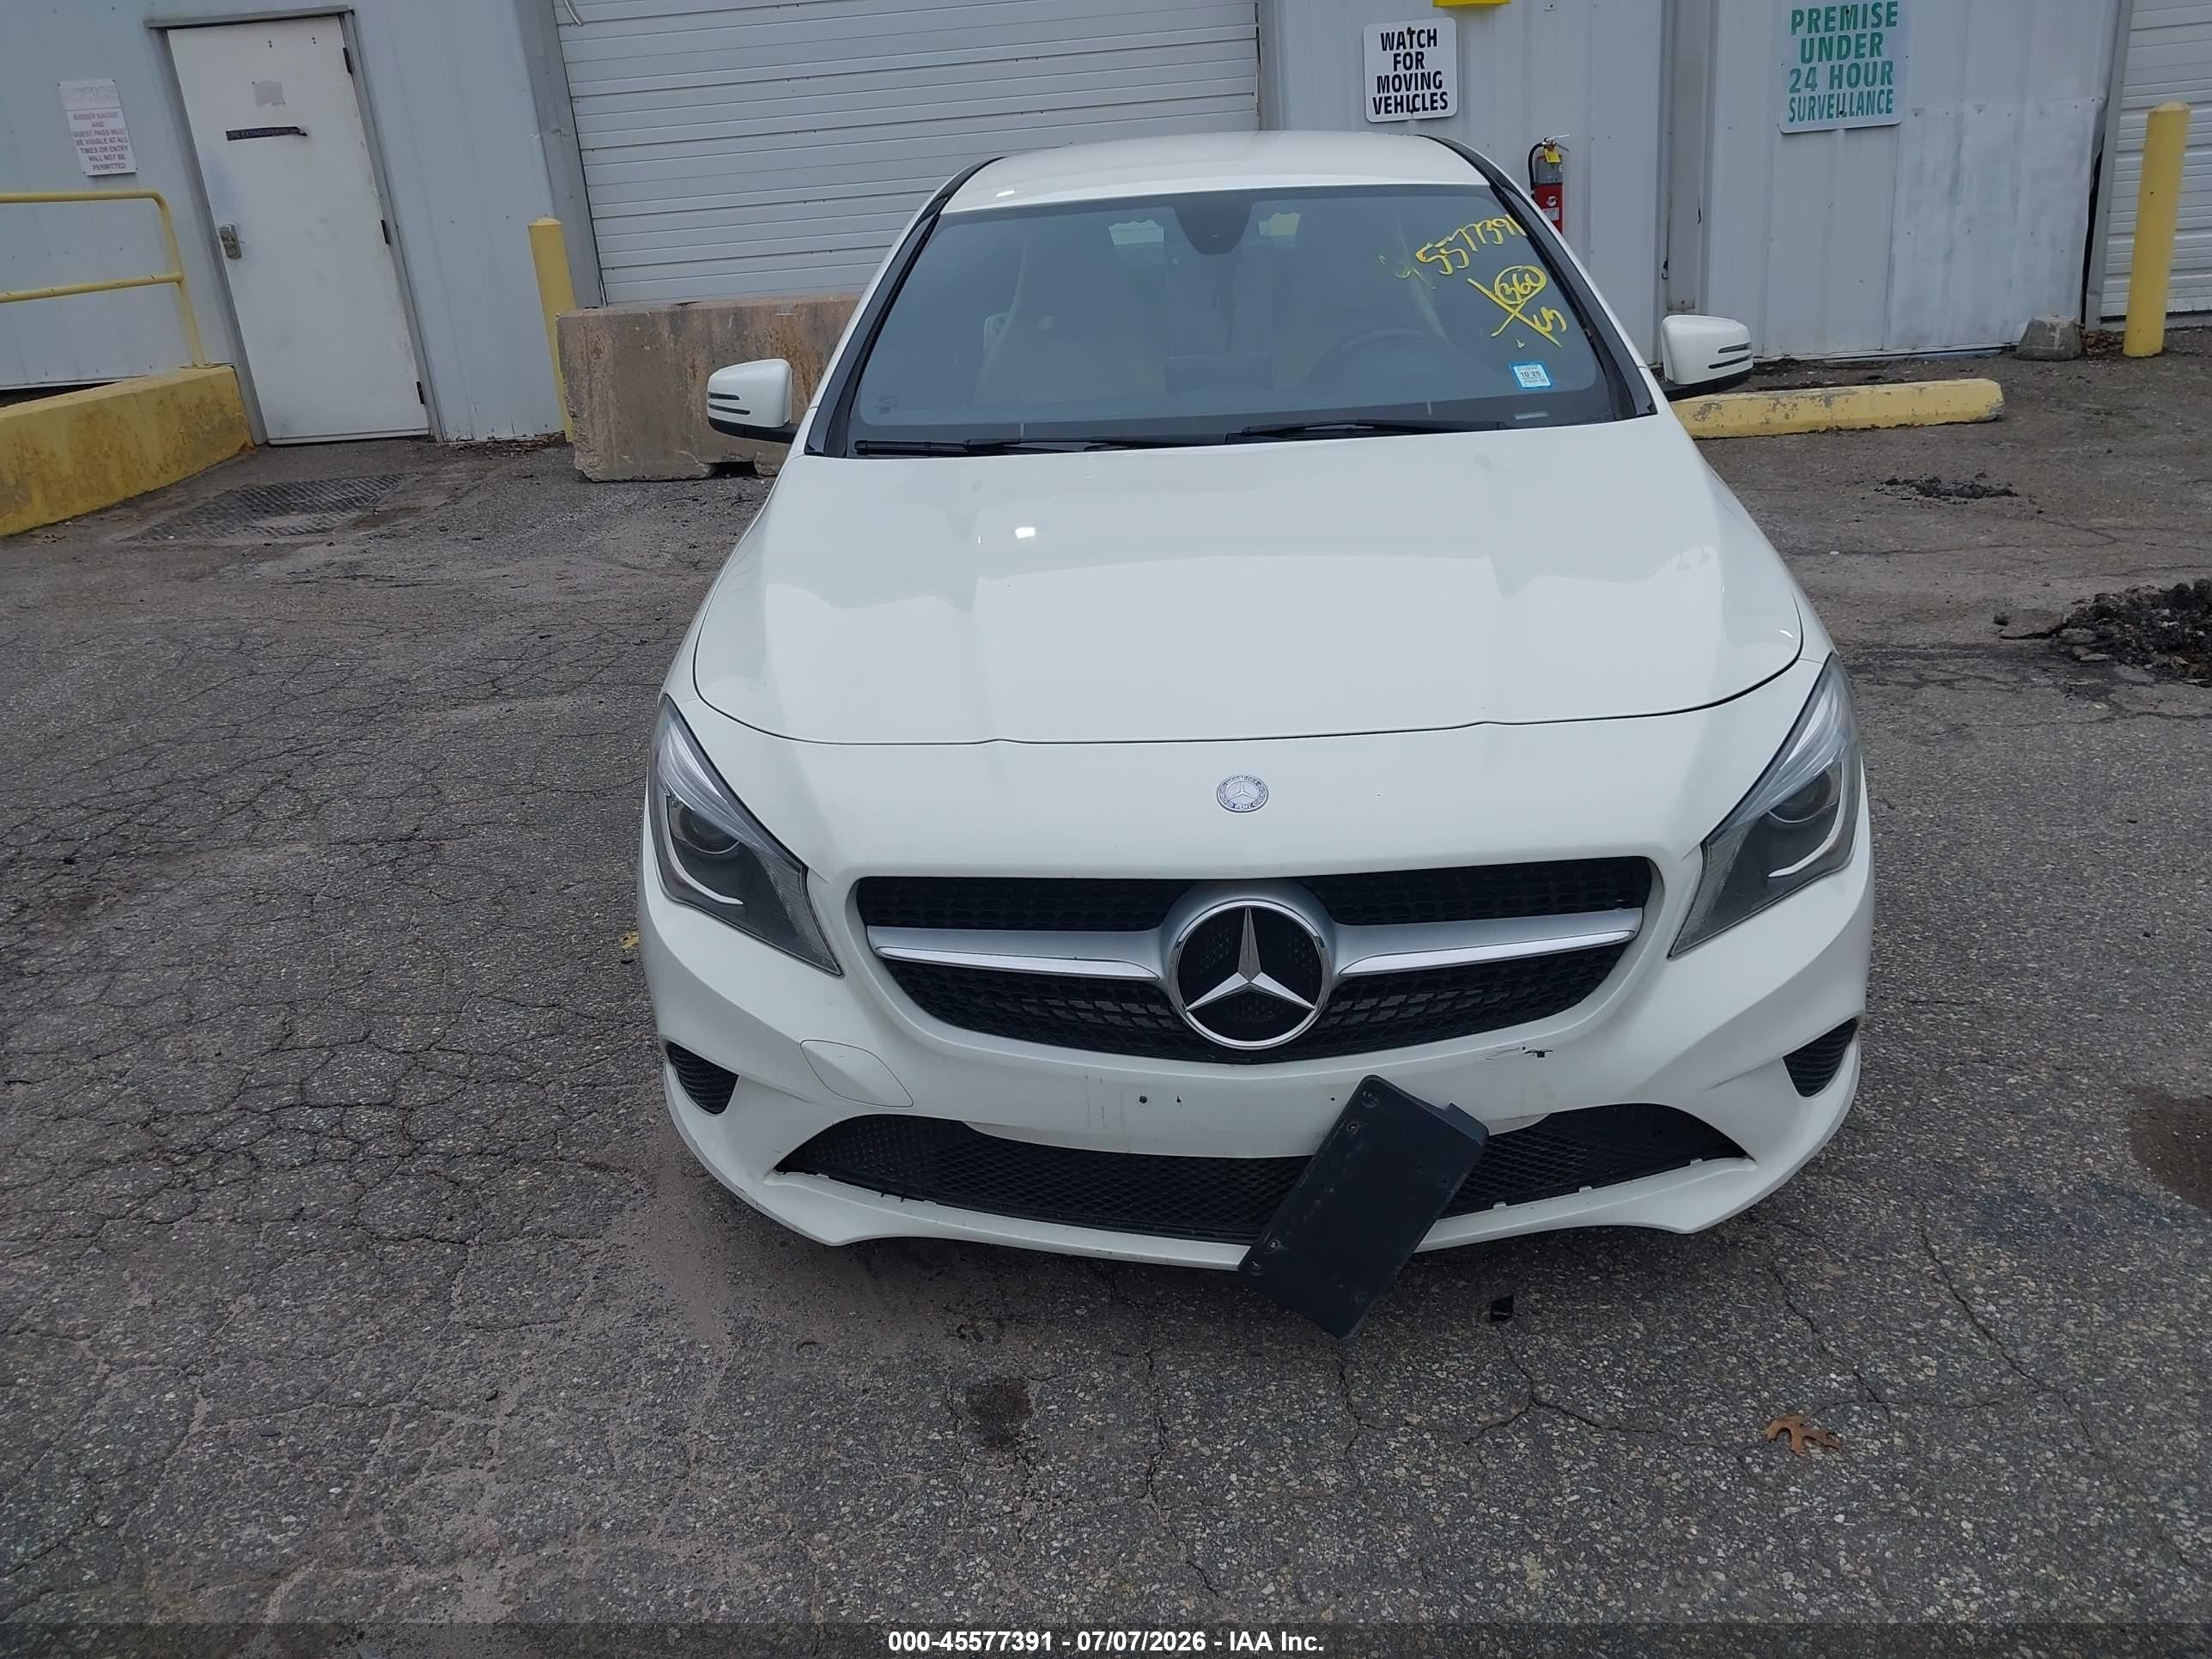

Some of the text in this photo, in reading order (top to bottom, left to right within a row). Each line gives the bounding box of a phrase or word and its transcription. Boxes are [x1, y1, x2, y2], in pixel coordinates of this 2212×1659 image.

[1790, 1, 1899, 35] PREMISE
[1380, 27, 1437, 52] WATCH
[1800, 32, 1884, 64] UNDER
[1393, 51, 1425, 72] FOR
[1376, 70, 1443, 94] MOVING
[1789, 60, 1894, 94] 24 HOUR
[1372, 91, 1449, 115] VEHICLES
[1789, 88, 1893, 123] SURVEILLANCE
